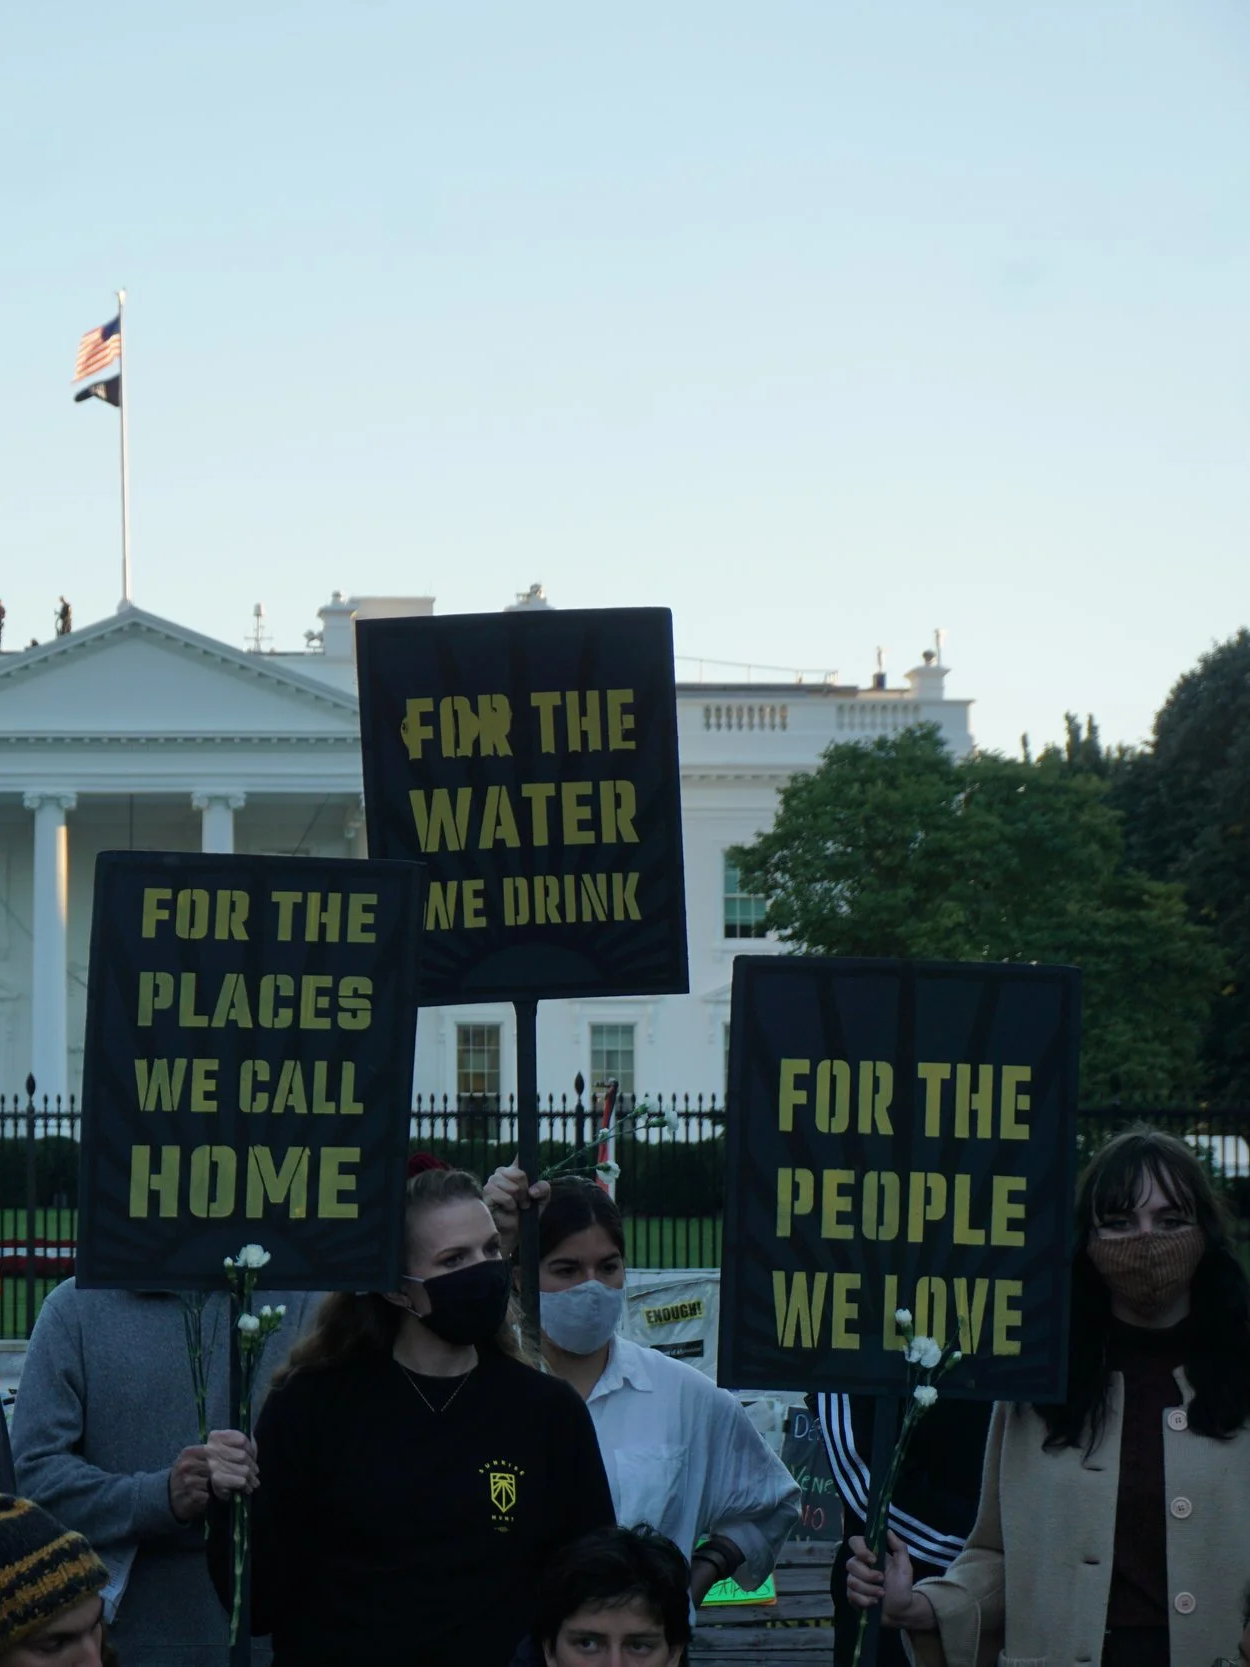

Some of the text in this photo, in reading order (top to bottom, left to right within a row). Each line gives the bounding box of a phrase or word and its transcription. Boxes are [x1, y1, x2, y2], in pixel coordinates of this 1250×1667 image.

[402, 688, 637, 760] FOR THE
[408, 779, 640, 853] WATER
[141, 887, 379, 943] FOR THE
[502, 871, 642, 927] DRINK
[137, 971, 374, 1031] PLACES
[134, 1057, 365, 1115] WE CALL
[778, 1058, 1032, 1140] FOR THE
[128, 1144, 362, 1220] HOME
[775, 1167, 1027, 1247] PEOPLE
[645, 1301, 703, 1325] ENOUGH!
[771, 1270, 1023, 1356] WE LOVE
